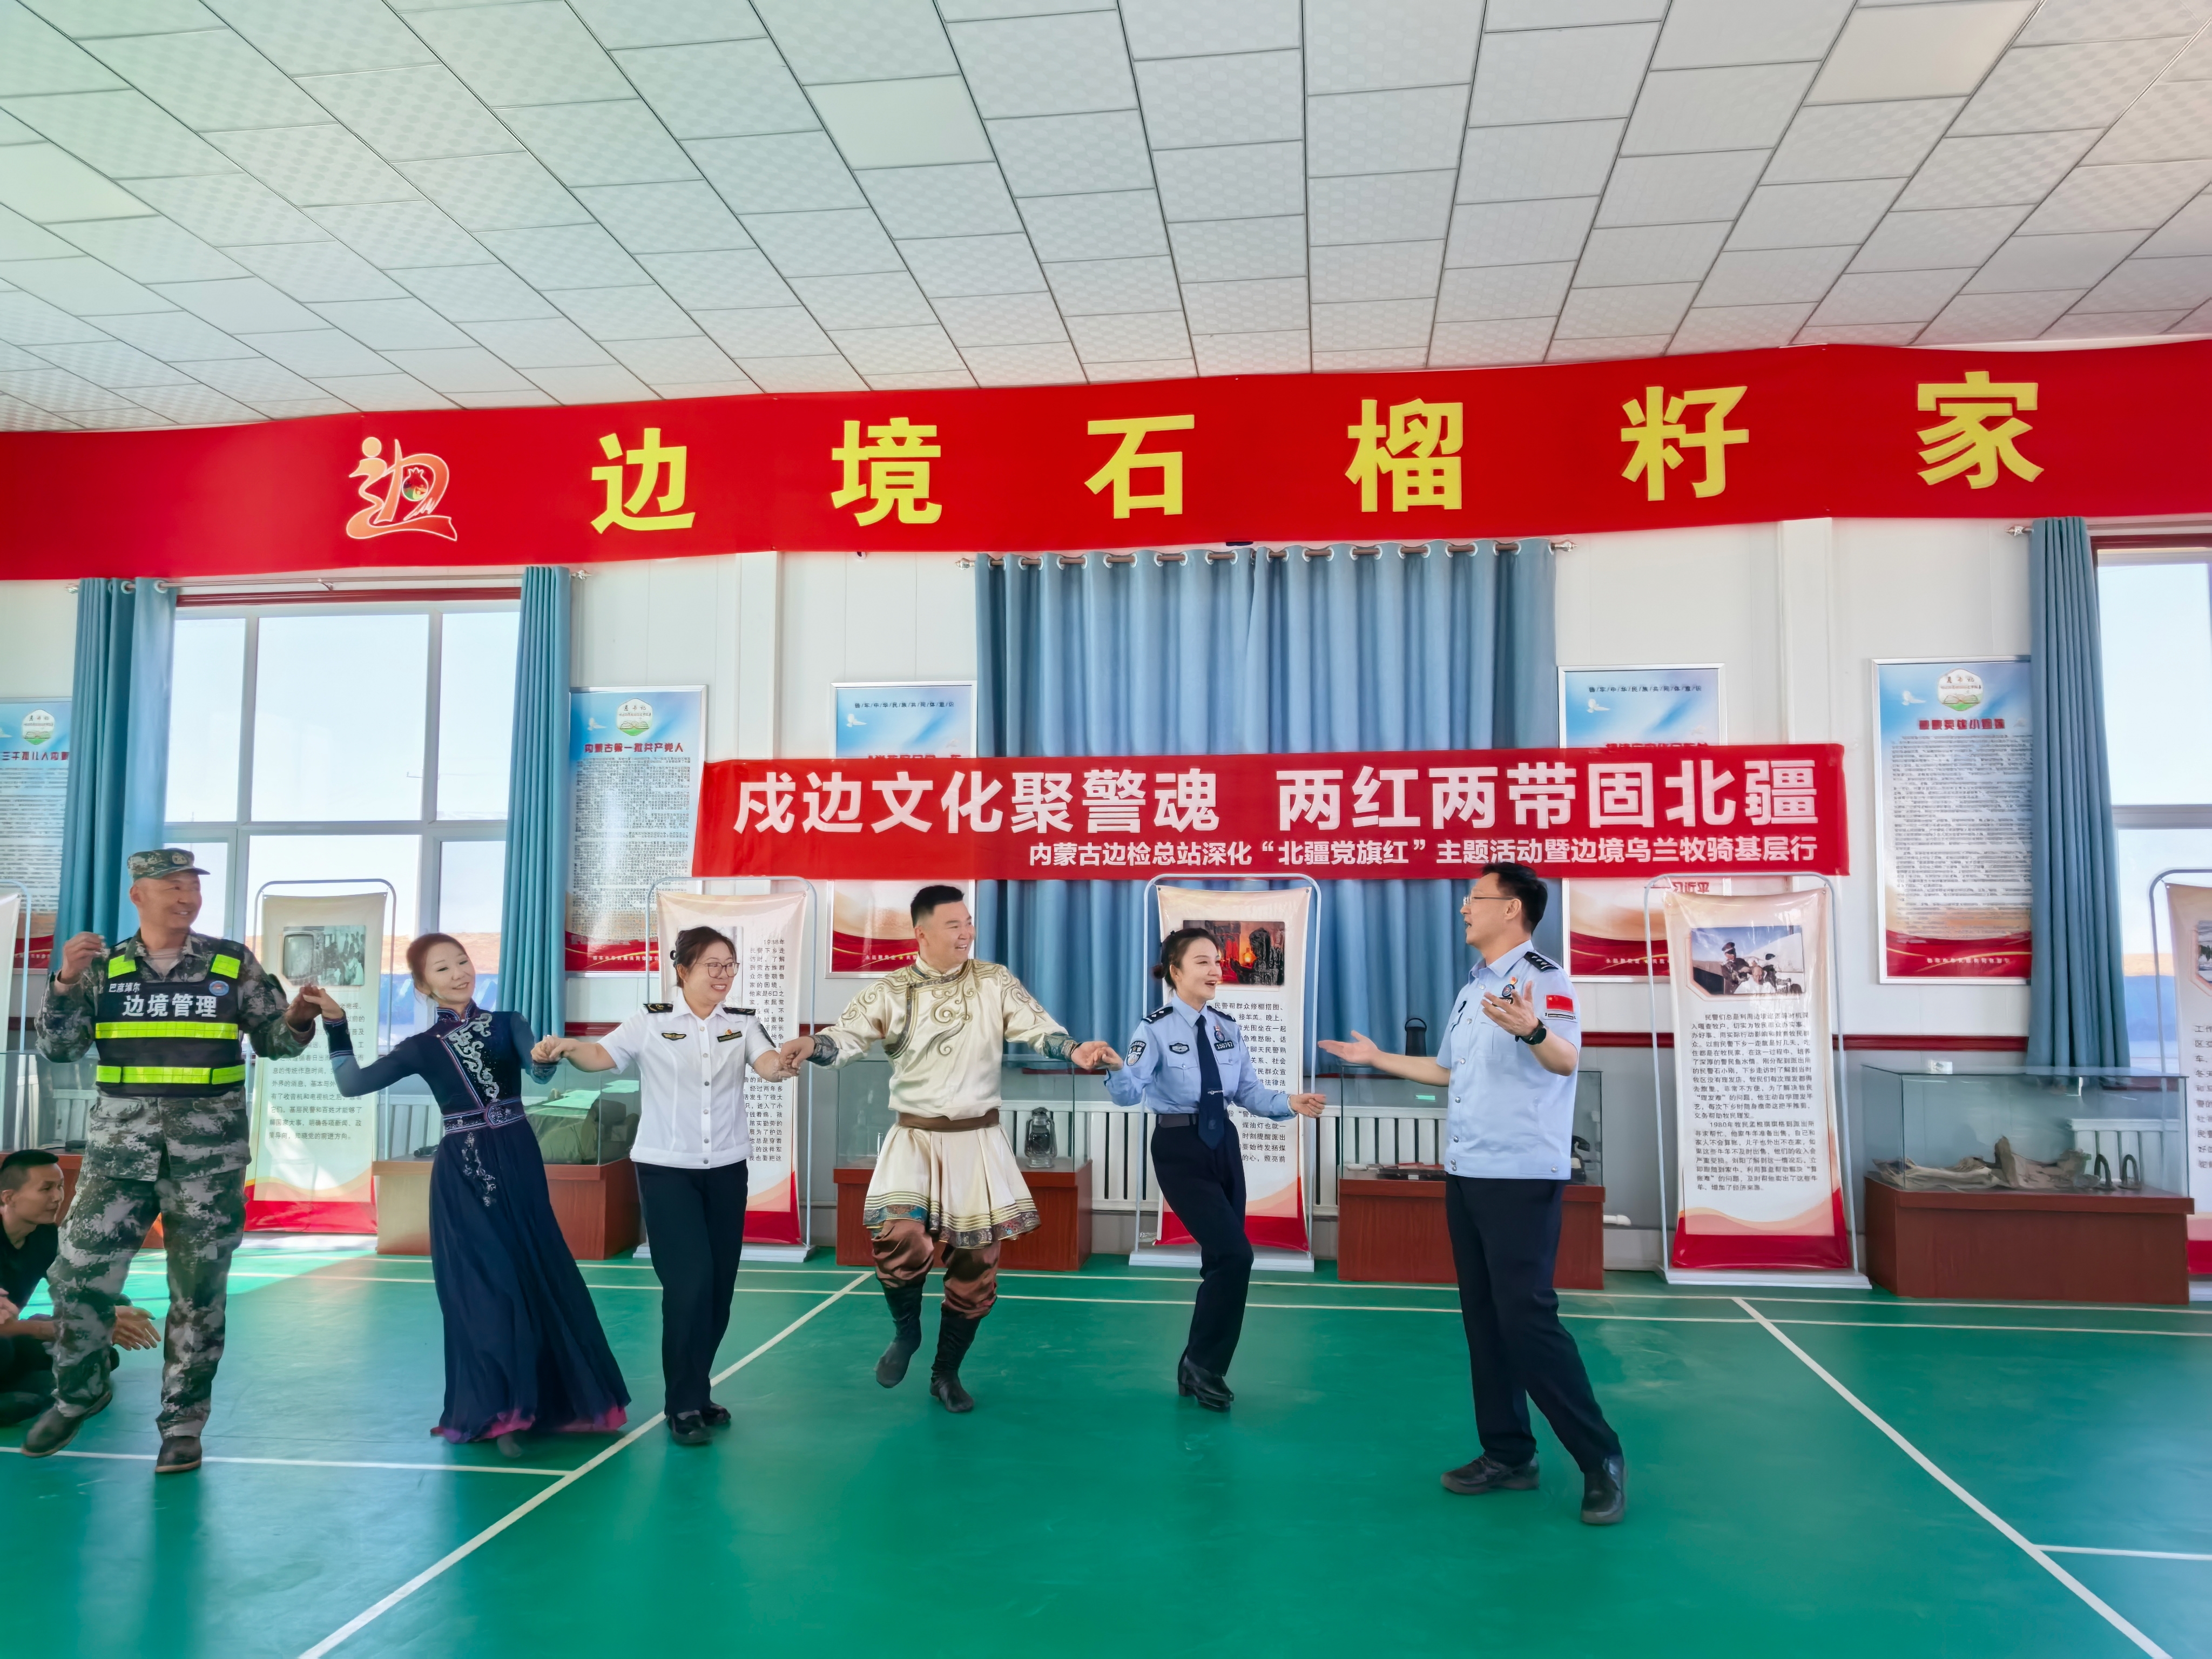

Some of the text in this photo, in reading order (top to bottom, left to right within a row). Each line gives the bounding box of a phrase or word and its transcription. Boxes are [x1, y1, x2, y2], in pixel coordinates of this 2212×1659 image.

[590, 370, 2044, 535] 边境石榴籽家
[732, 768, 1219, 835] 戍边文化聚警魂
[1276, 760, 1818, 831] 两红两带固北疆
[109, 983, 141, 993] 巴彦淖尔
[122, 994, 217, 1018] 边境管理
